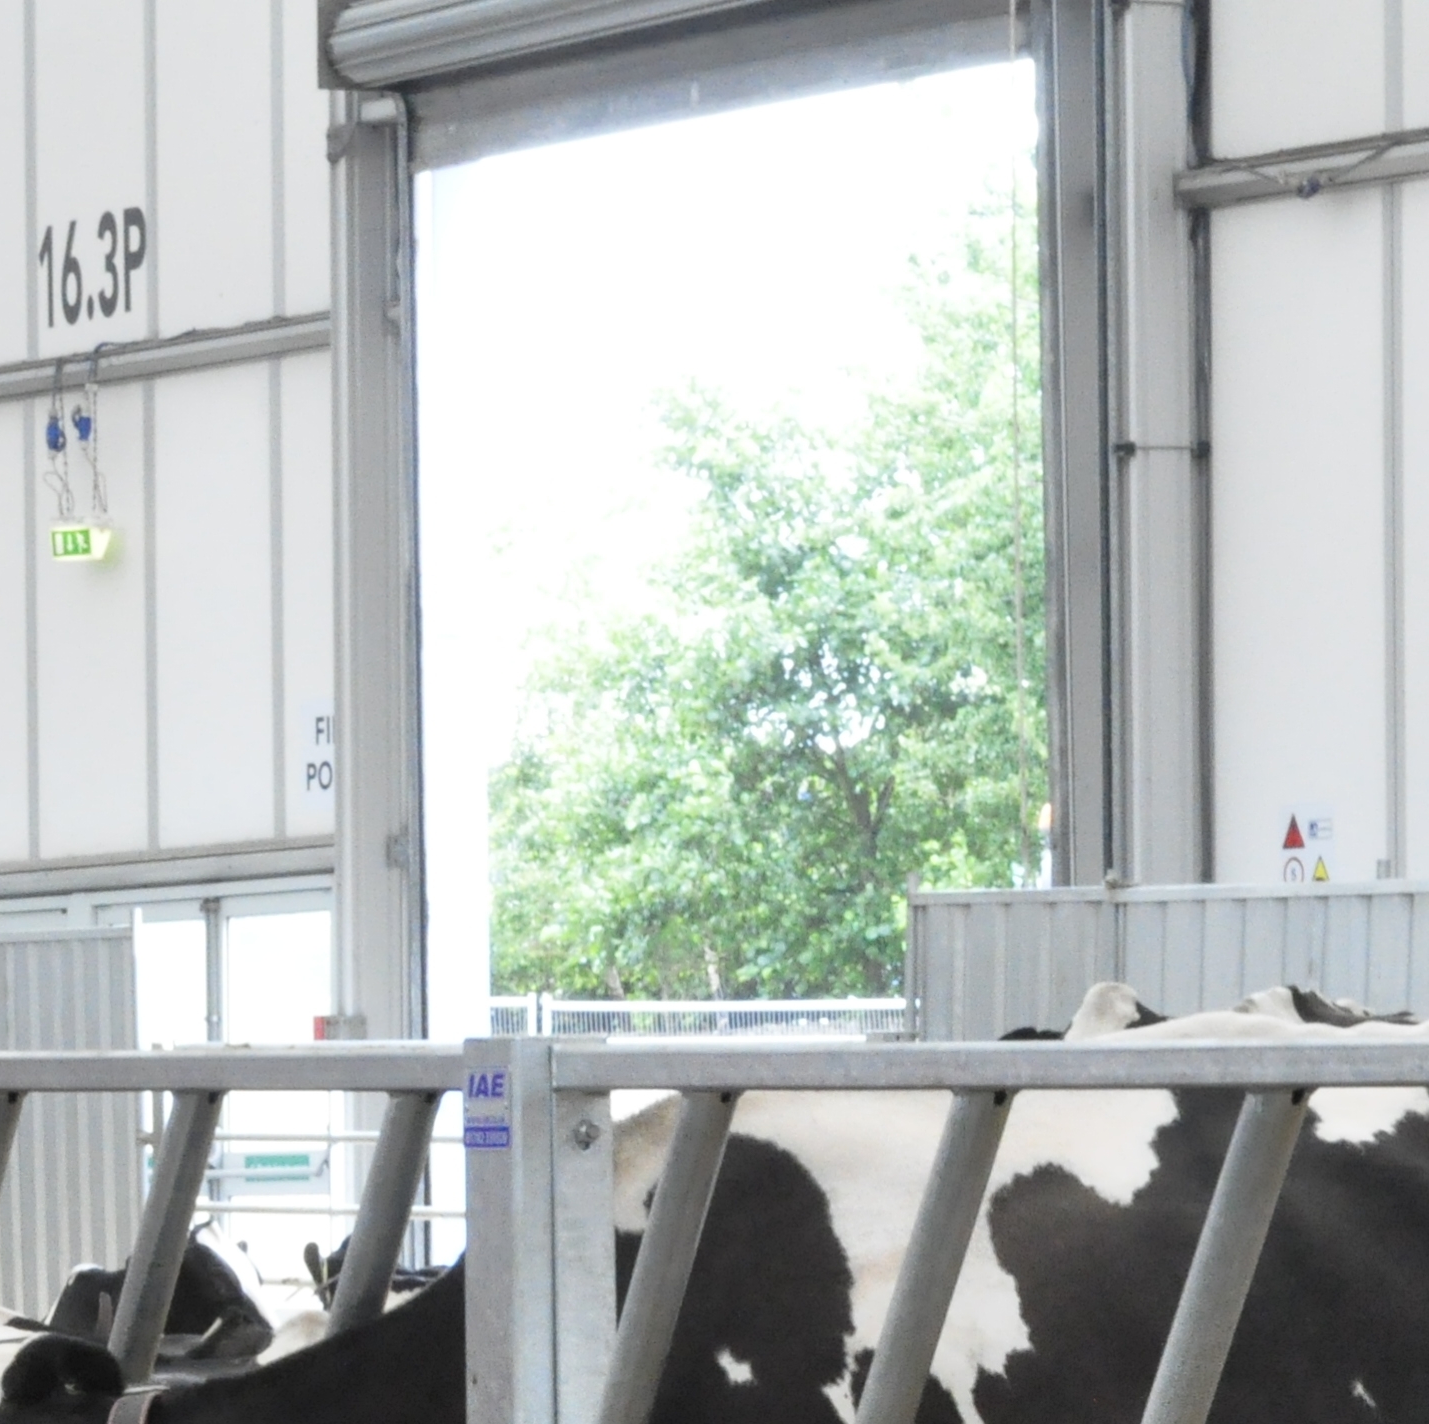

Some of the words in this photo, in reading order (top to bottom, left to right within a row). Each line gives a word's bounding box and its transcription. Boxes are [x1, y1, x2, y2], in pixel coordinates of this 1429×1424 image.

[39, 206, 147, 328] 16.3P
[315, 715, 335, 746] FI
[468, 1073, 505, 1098] IAE
